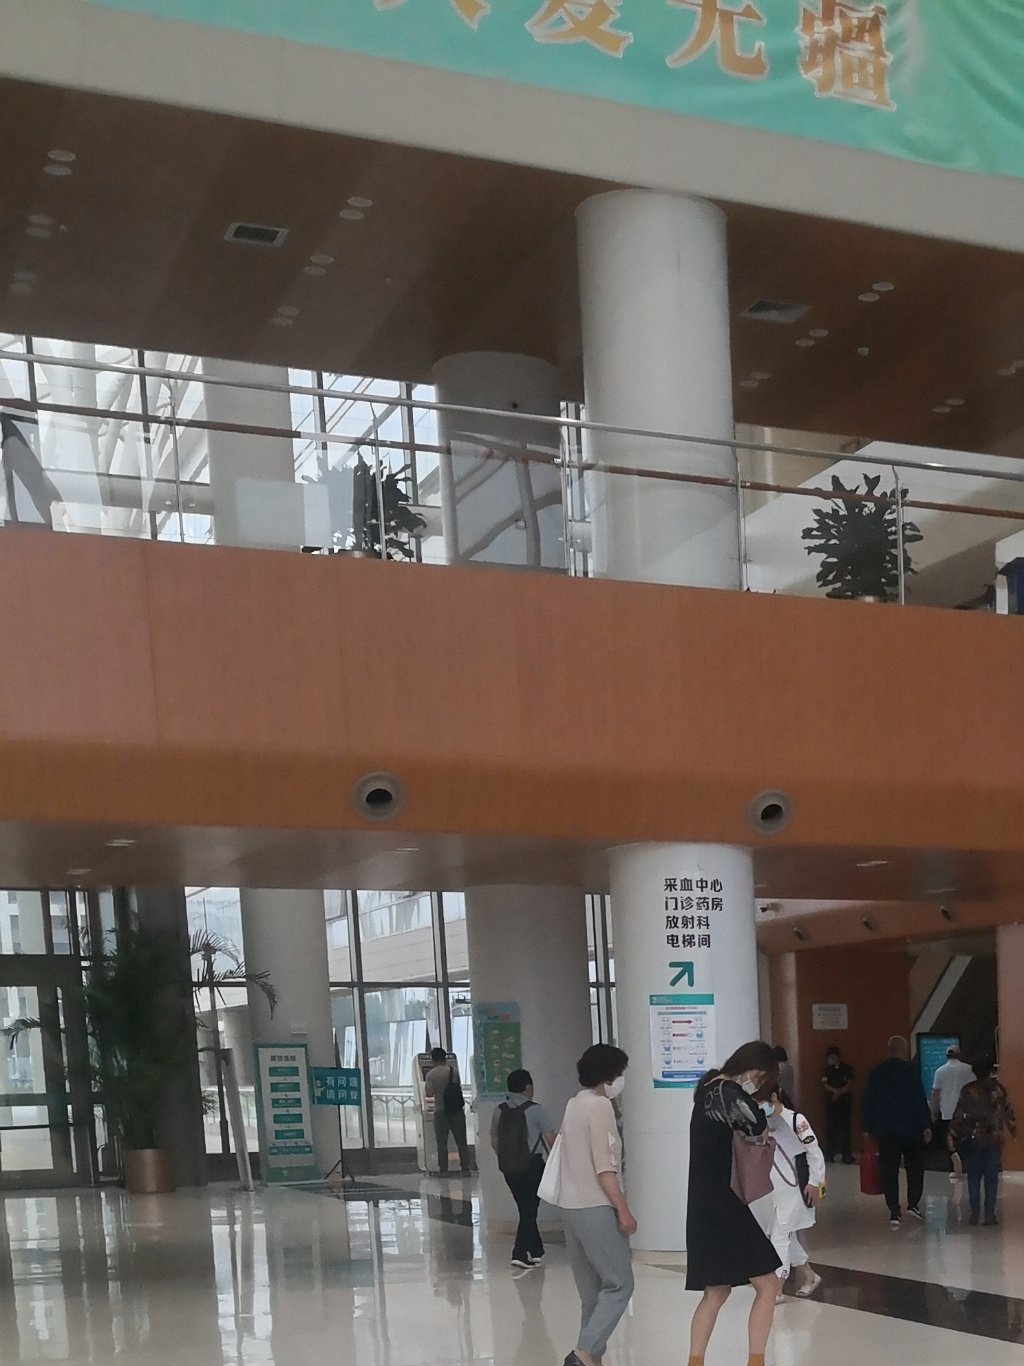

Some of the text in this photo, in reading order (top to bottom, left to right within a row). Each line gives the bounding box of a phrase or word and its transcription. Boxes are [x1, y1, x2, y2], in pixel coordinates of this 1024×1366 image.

[663, 876, 723, 893] 采血中心
[664, 895, 724, 912] 门诊药房
[665, 914, 711, 930] 放射科
[666, 933, 712, 949] 电梯间
